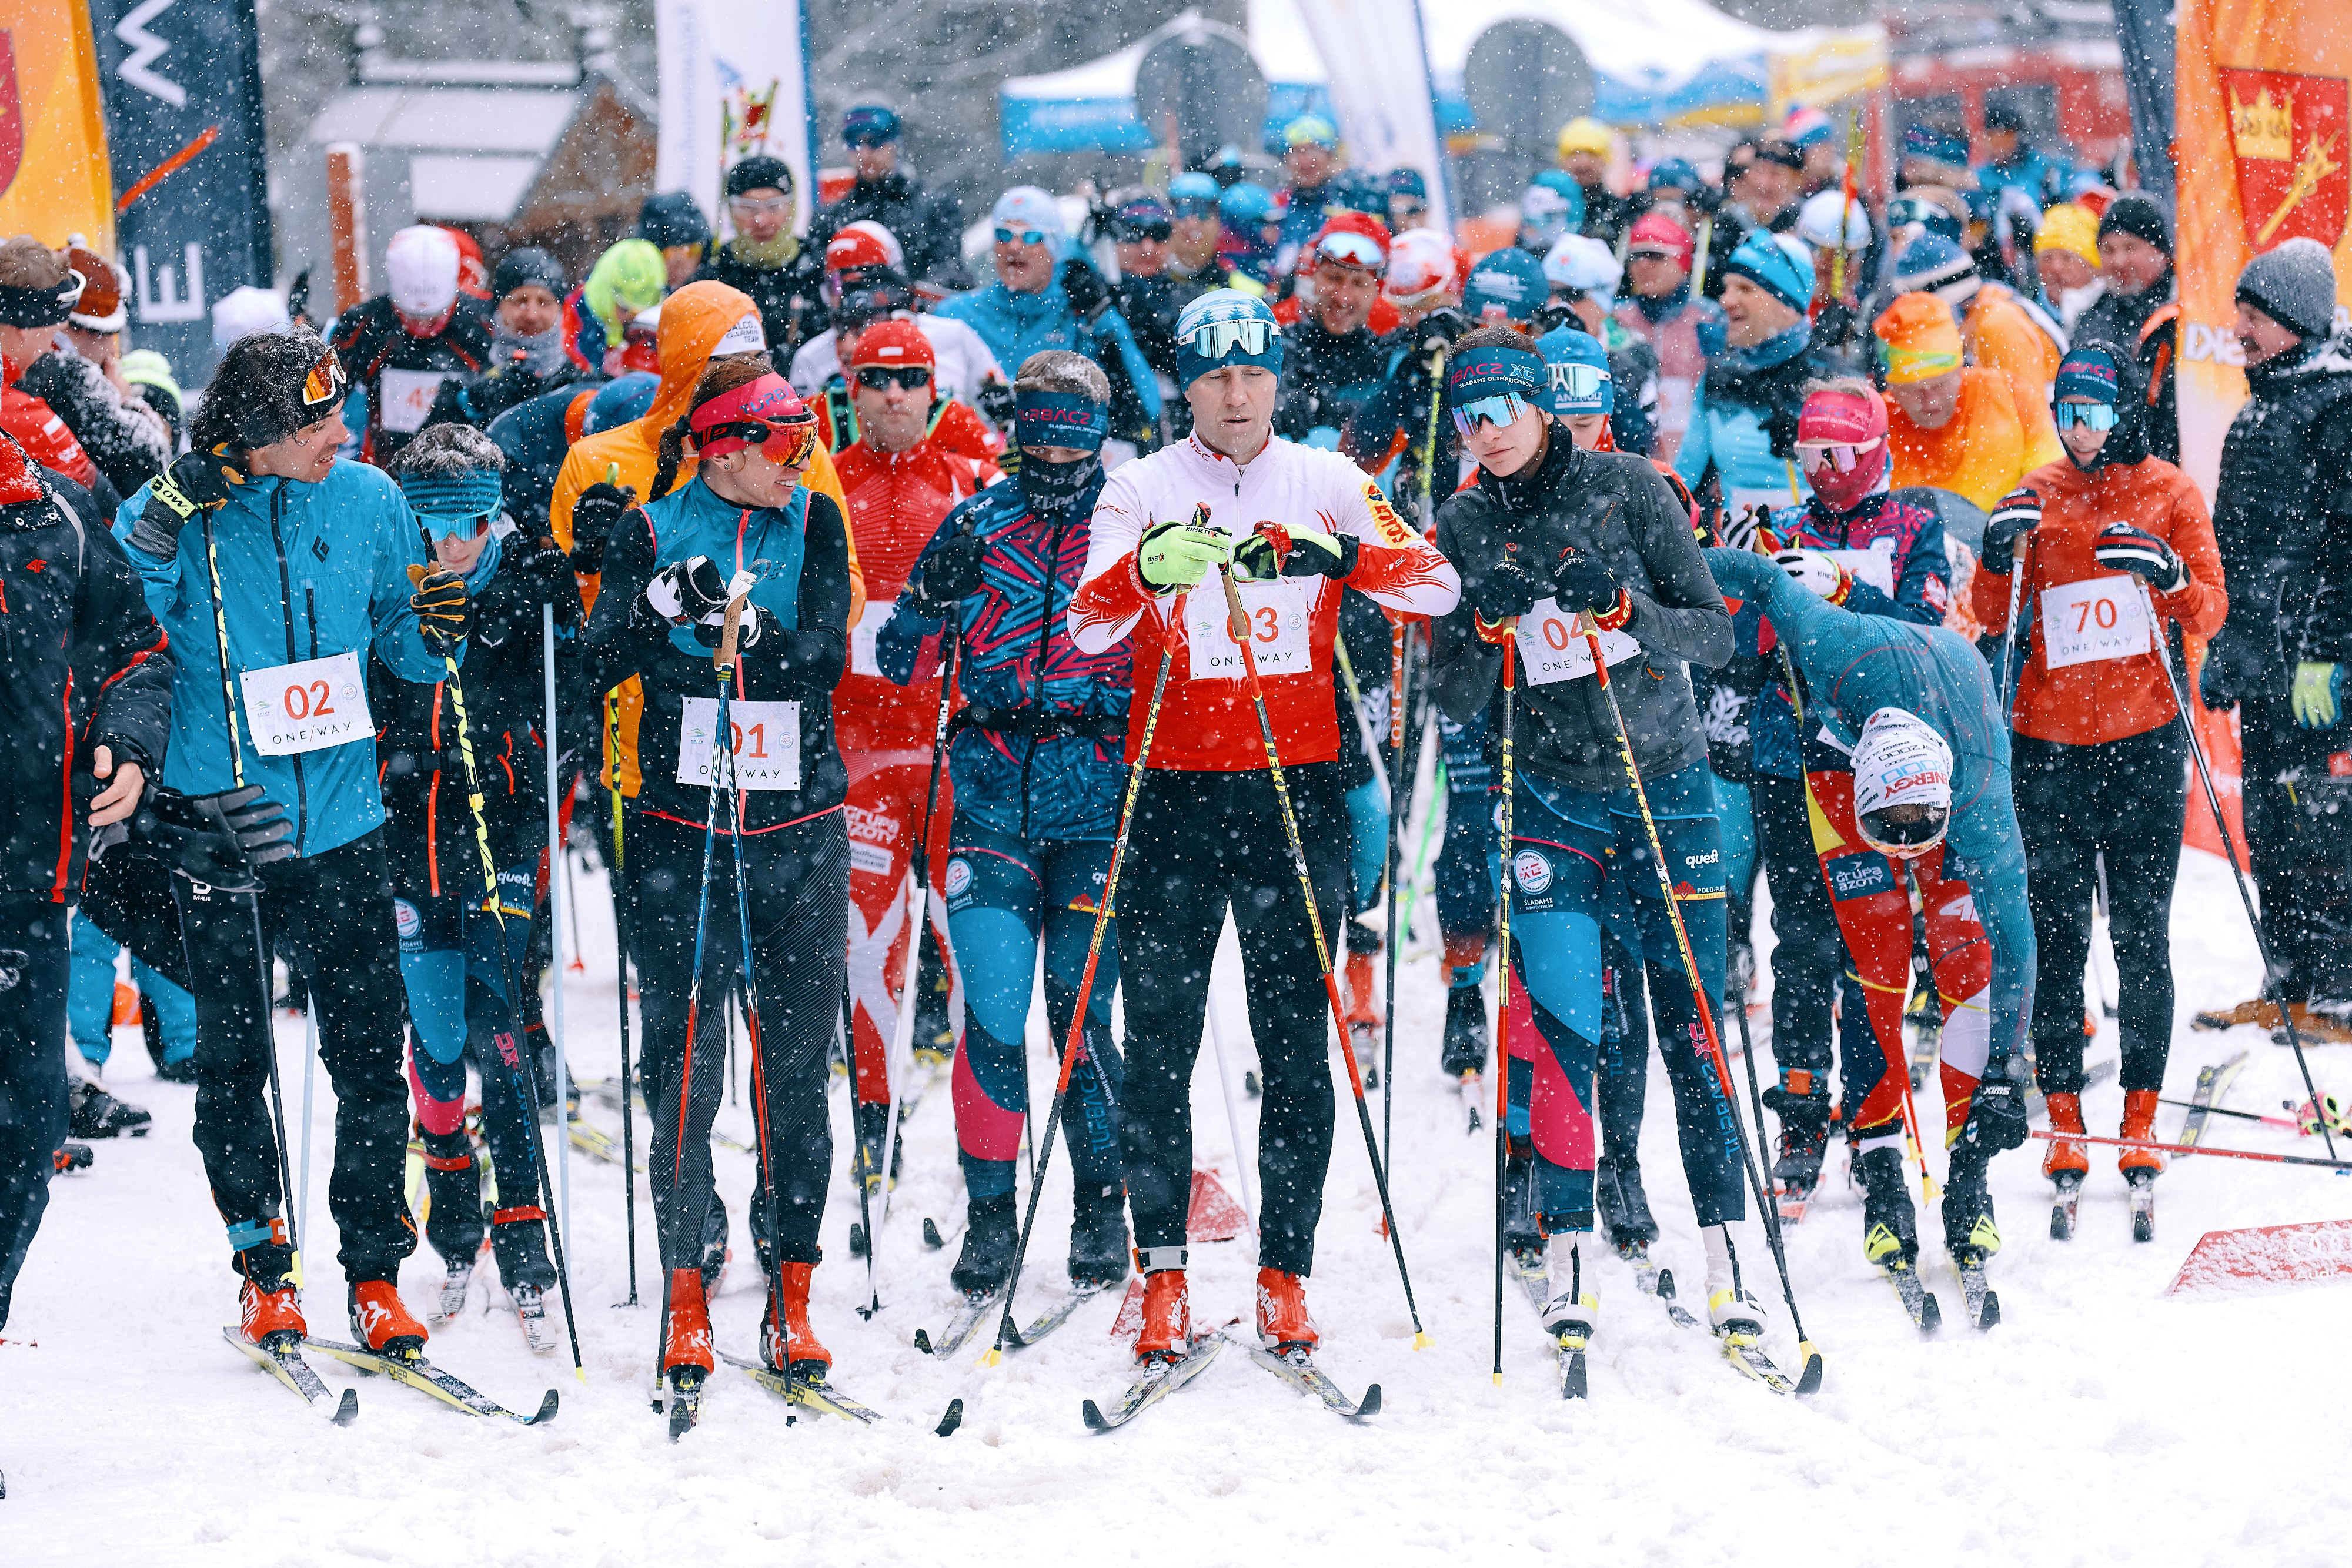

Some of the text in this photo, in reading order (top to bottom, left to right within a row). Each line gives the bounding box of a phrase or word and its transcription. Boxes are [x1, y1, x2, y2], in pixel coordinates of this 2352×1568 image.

[726, 329, 759, 339] GARMIN
[744, 335, 759, 344] TEAM
[1459, 374, 1533, 389] ŚLADAMI OLIMPIJCZYKÓW
[1509, 363, 1535, 382] XC
[1374, 504, 1411, 544] LOTOS
[26, 559, 48, 574] 4F
[1555, 557, 1578, 577] CRAFT
[1227, 607, 1279, 644] 03
[1616, 592, 1631, 627] LEKI
[2071, 598, 2117, 634] 70
[284, 680, 335, 720] 02
[936, 699, 950, 741] FORCE
[1141, 701, 1161, 757] LEKI
[723, 721, 768, 758] 01
[1264, 741, 1286, 792] LEKI
[1502, 737, 1514, 794] LEKI
[1885, 771, 1948, 800] ENERGY
[1636, 794, 1661, 848] LEKI
[1685, 848, 1719, 869] quest
[1524, 897, 1553, 906] ŚLADAMI
[1532, 881, 1546, 891] COUNTRY
[1983, 1086, 2012, 1095] SWIX
